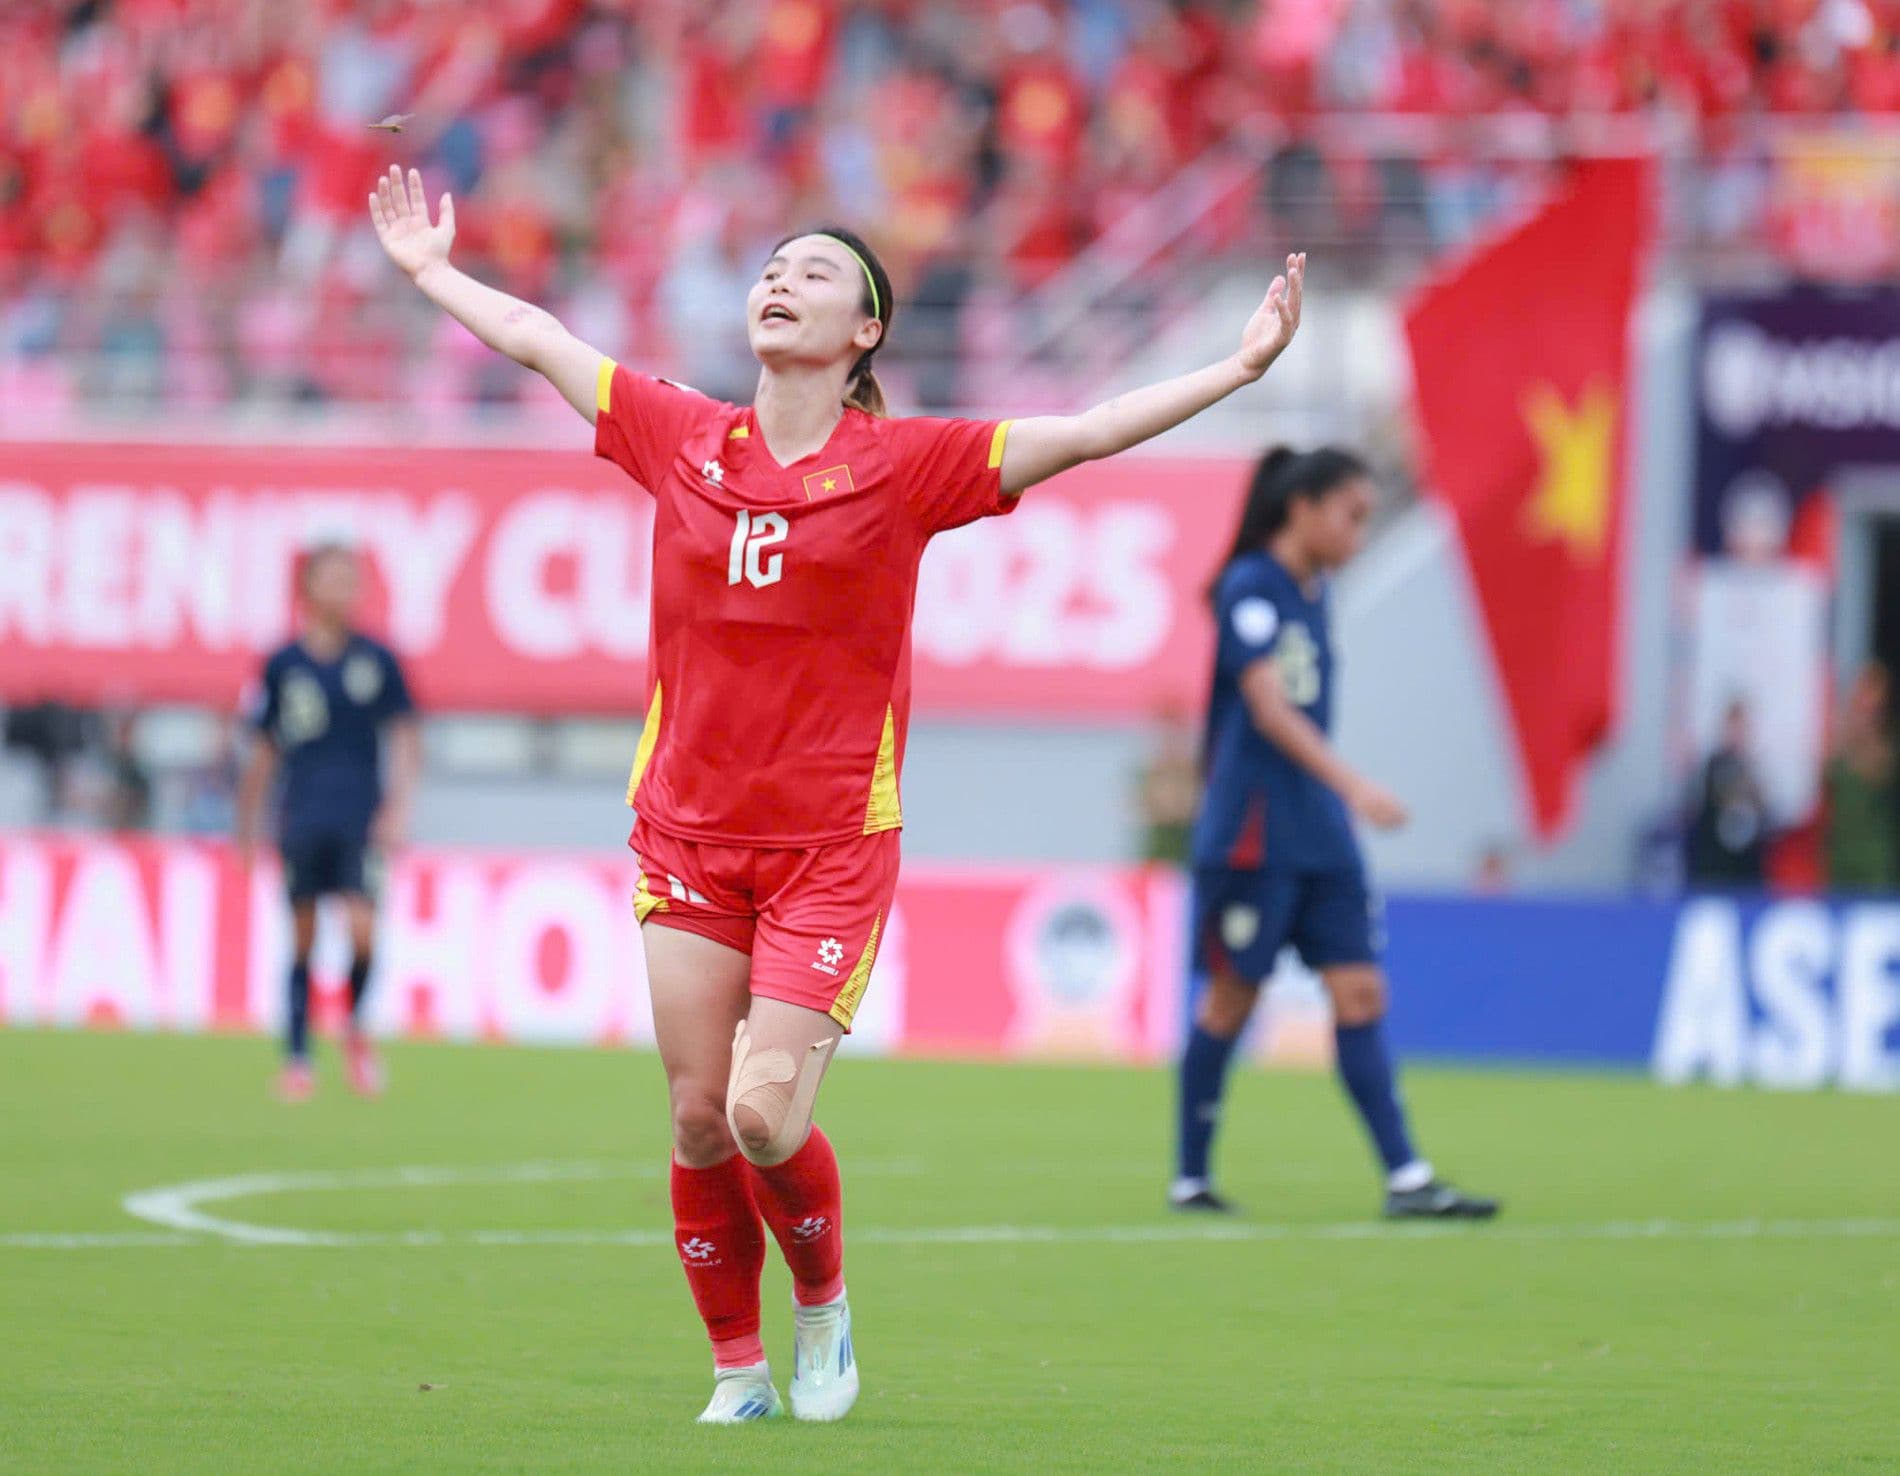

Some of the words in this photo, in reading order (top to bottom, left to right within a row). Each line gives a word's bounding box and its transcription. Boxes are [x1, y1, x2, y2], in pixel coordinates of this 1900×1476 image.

[485, 490, 652, 659] CU
[911, 498, 1177, 669] 025
[728, 508, 789, 589] 12
